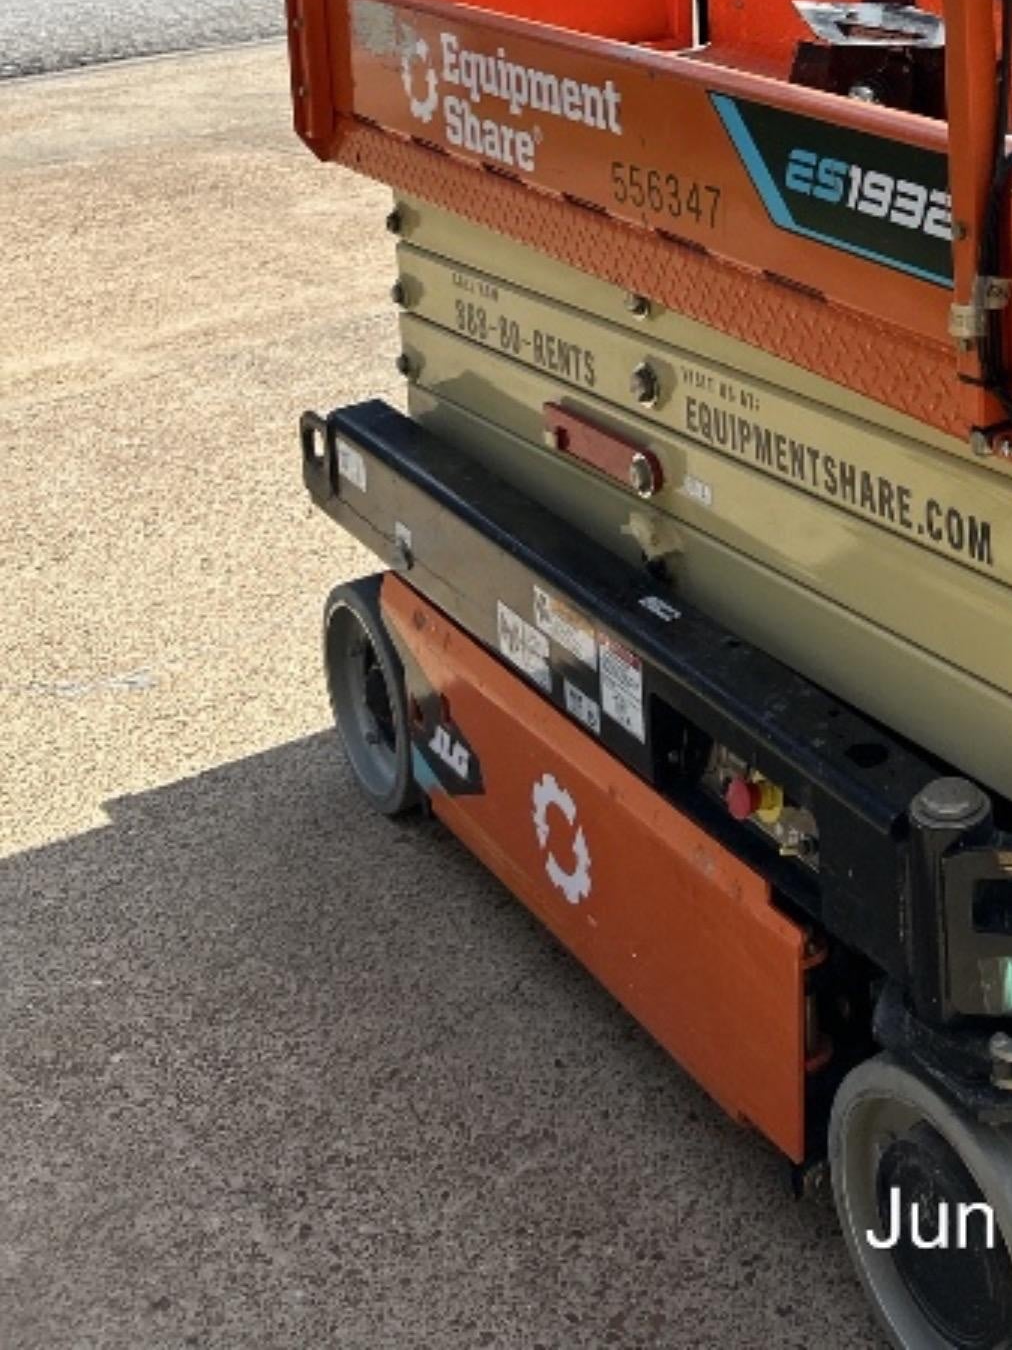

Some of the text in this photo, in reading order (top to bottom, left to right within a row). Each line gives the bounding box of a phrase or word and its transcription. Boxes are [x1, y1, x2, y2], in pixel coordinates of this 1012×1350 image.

[440, 32, 622, 135] Equipment
[443, 95, 535, 172] Share
[611, 161, 721, 228] 556347
[785, 148, 954, 241] ES1932
[686, 394, 993, 565] EQUIPMENTSHARE.COM
[428, 724, 469, 780] JLG
